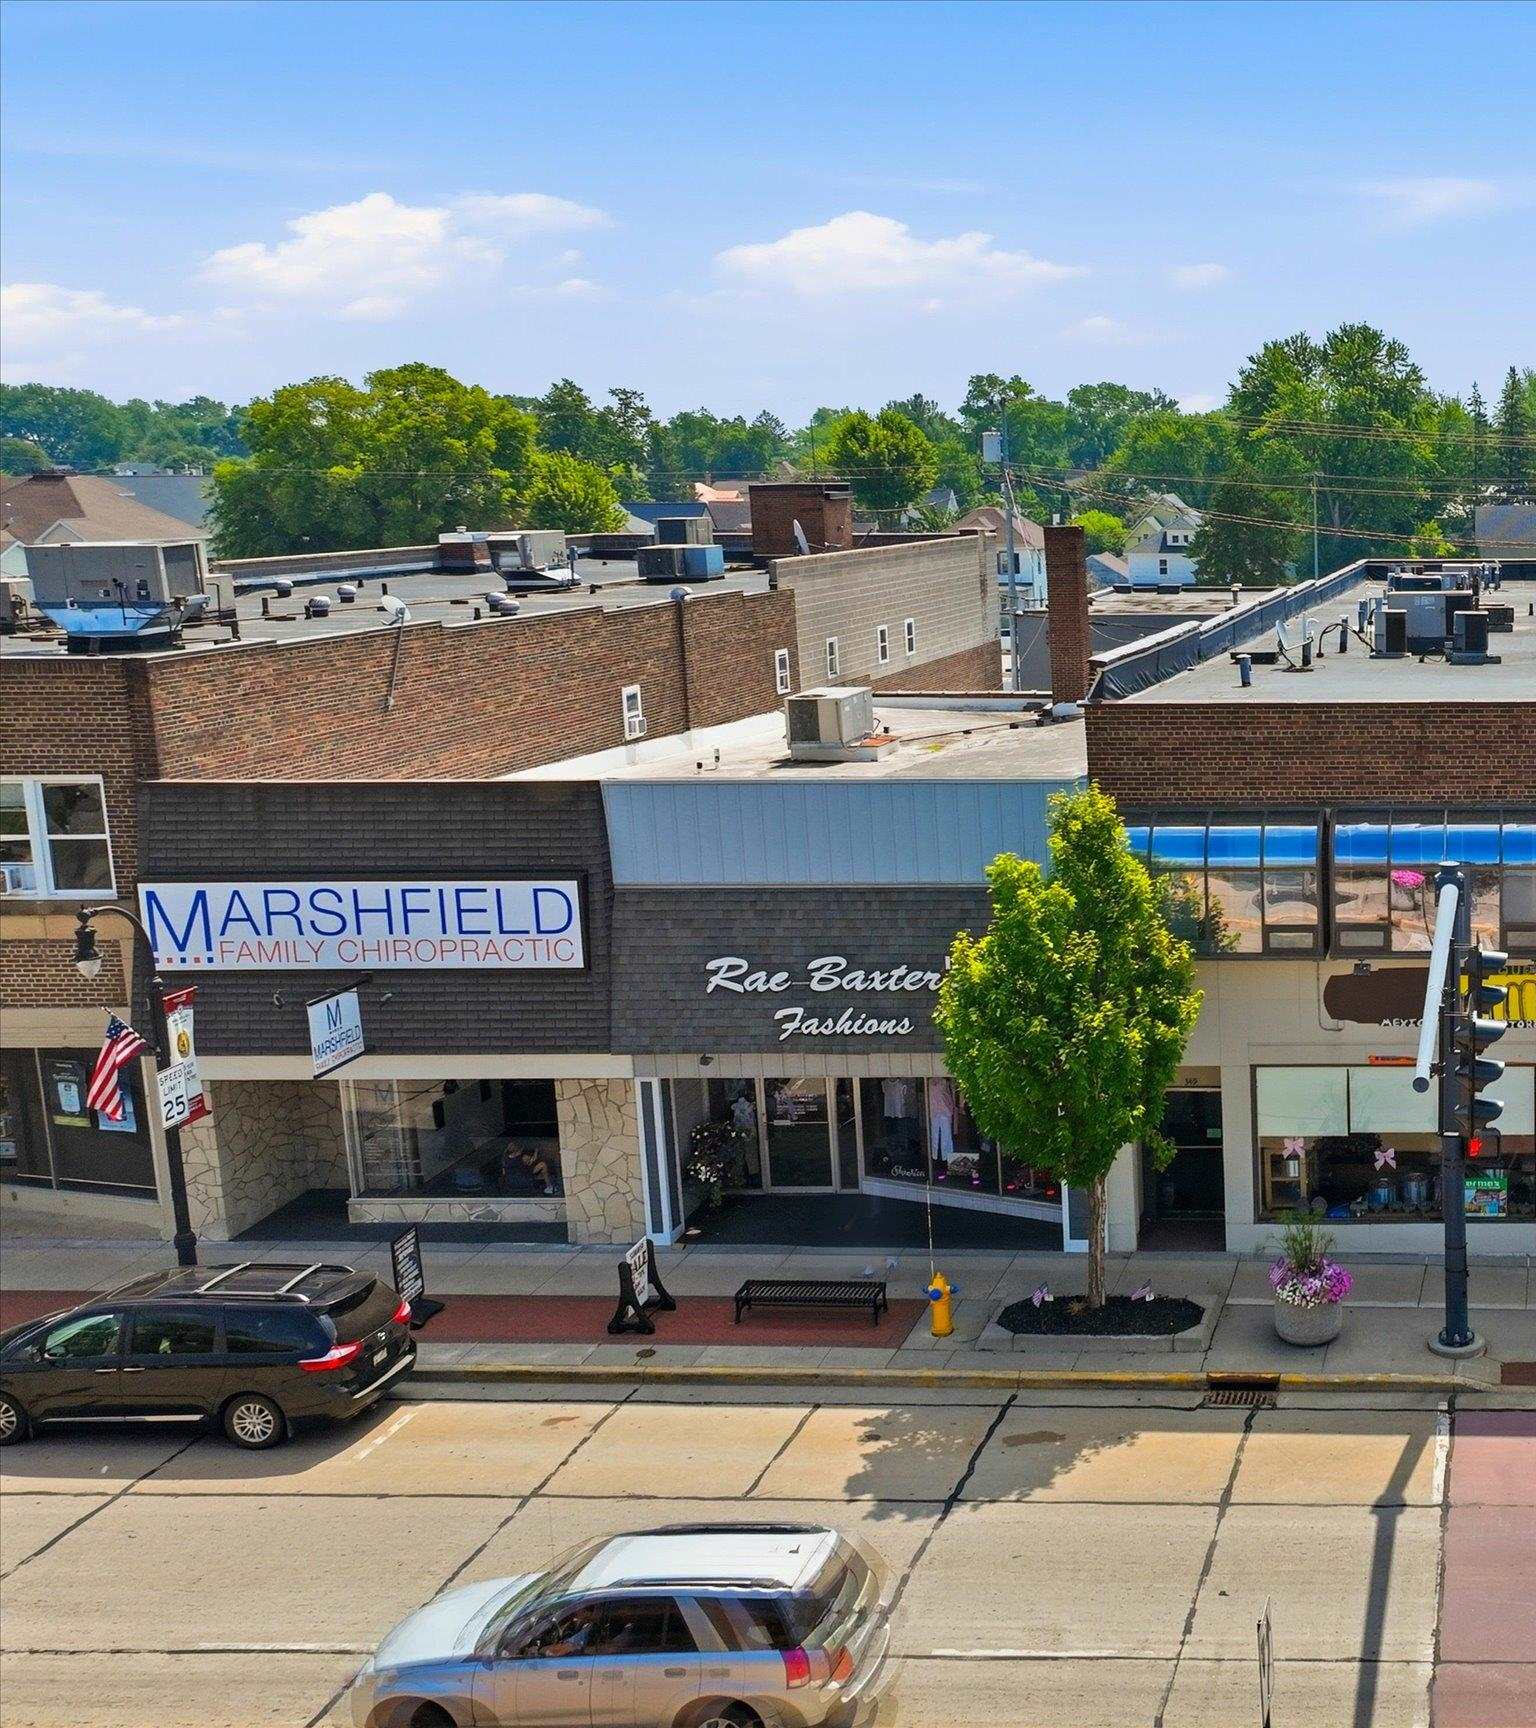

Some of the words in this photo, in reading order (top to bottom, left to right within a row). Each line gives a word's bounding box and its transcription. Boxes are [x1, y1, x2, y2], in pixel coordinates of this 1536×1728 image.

[145, 888, 573, 952] MARSHFIELD
[220, 939, 325, 963] FAMILY
[337, 938, 575, 963] CHIROPRACTIC
[705, 956, 793, 993] Rae
[806, 955, 950, 992] Baxter'
[326, 999, 342, 1030] M
[774, 1006, 914, 1041] Fashions
[159, 1072, 182, 1087] SPEED
[163, 1084, 182, 1097] LIMIT
[163, 1095, 186, 1122] 25
